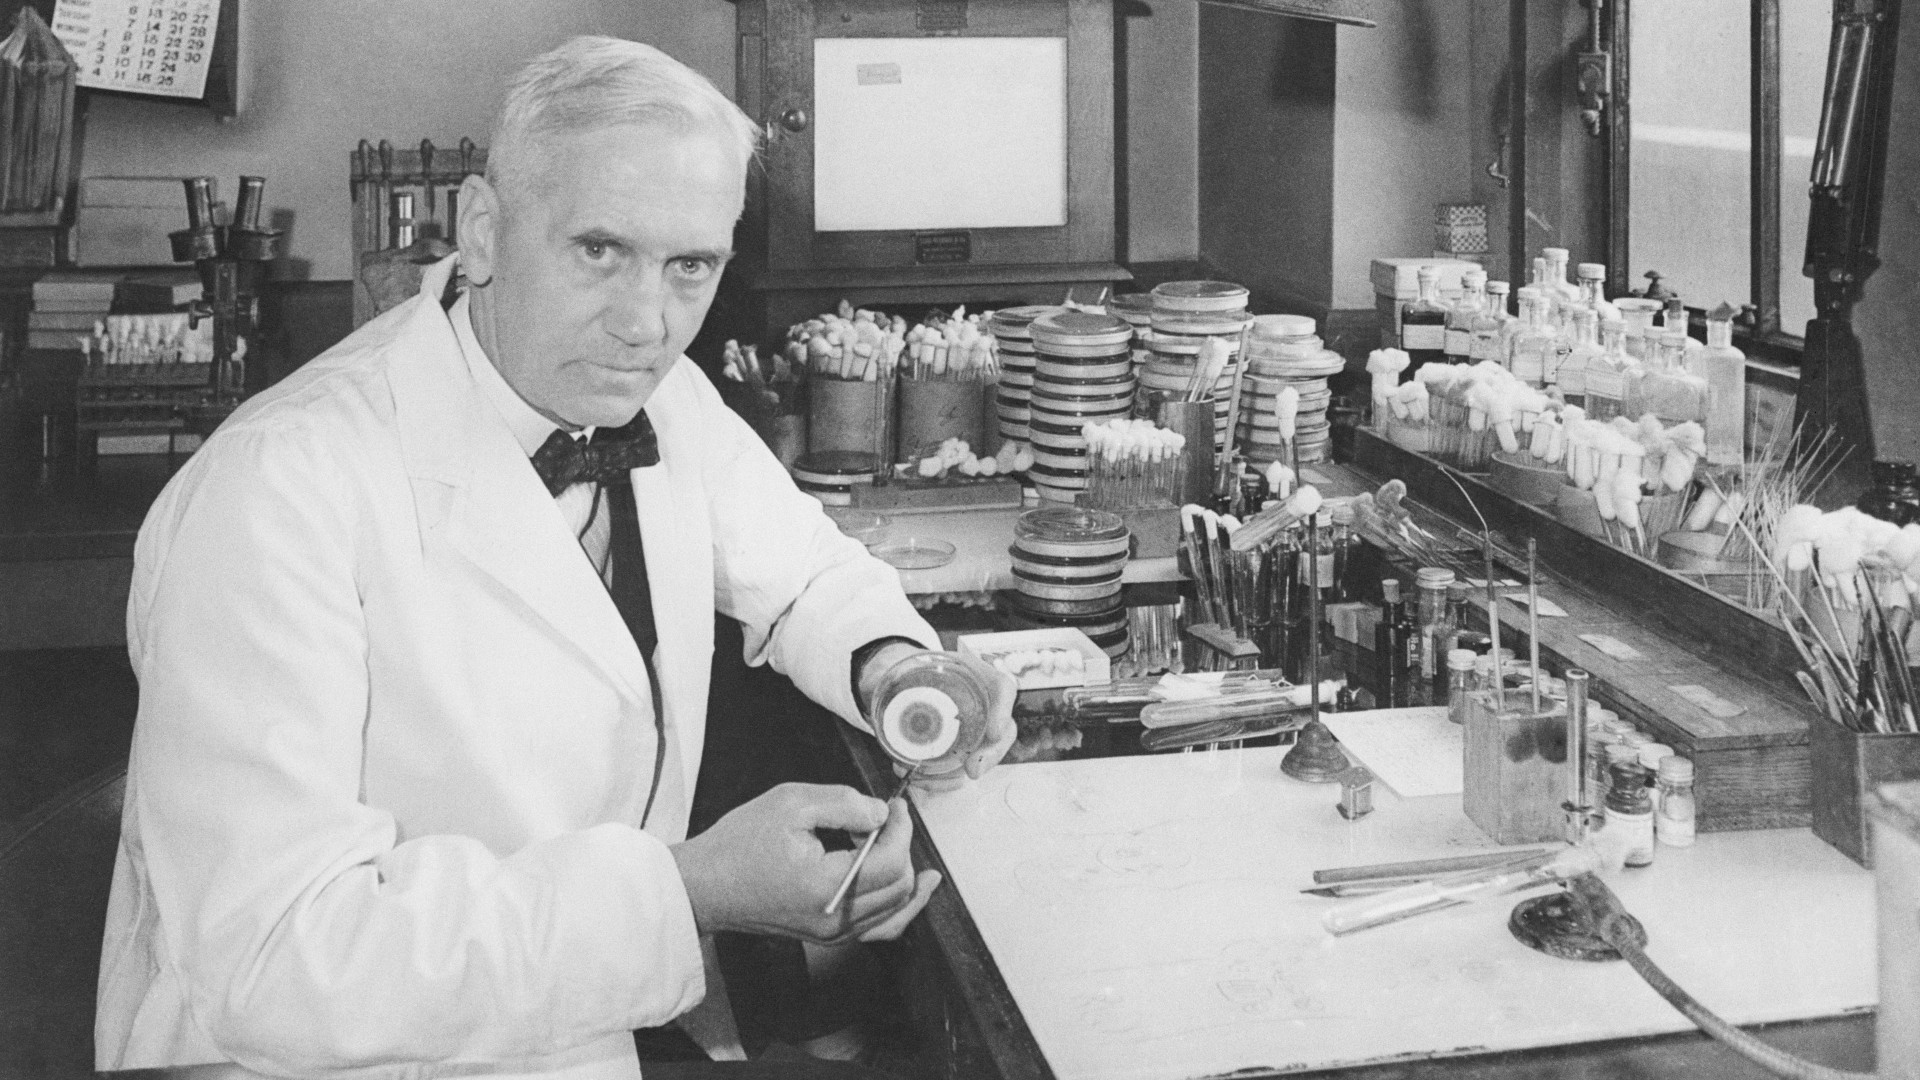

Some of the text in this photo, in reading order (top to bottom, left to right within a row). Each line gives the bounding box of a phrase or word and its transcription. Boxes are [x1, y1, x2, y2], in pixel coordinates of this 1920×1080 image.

[148, 8, 163, 18] 13
[170, 11, 187, 22] 20
[193, 14, 209, 24] 27
[128, 18, 136, 28] 7
[147, 21, 160, 32] 14
[170, 24, 184, 35] 21
[190, 26, 207, 37] 28
[96, 40, 106, 51] 2
[121, 44, 130, 54] 9
[141, 47, 156, 57] 16
[163, 50, 179, 61] 23
[184, 52, 201, 63] 30
[165, 37, 182, 48] 22
[187, 39, 205, 50] 29
[95, 54, 176, 72] 3 10 17 24
[92, 67, 101, 76] 4
[115, 70, 126, 80] 11
[137, 73, 152, 83] 18
[157, 75, 174, 86] 25
